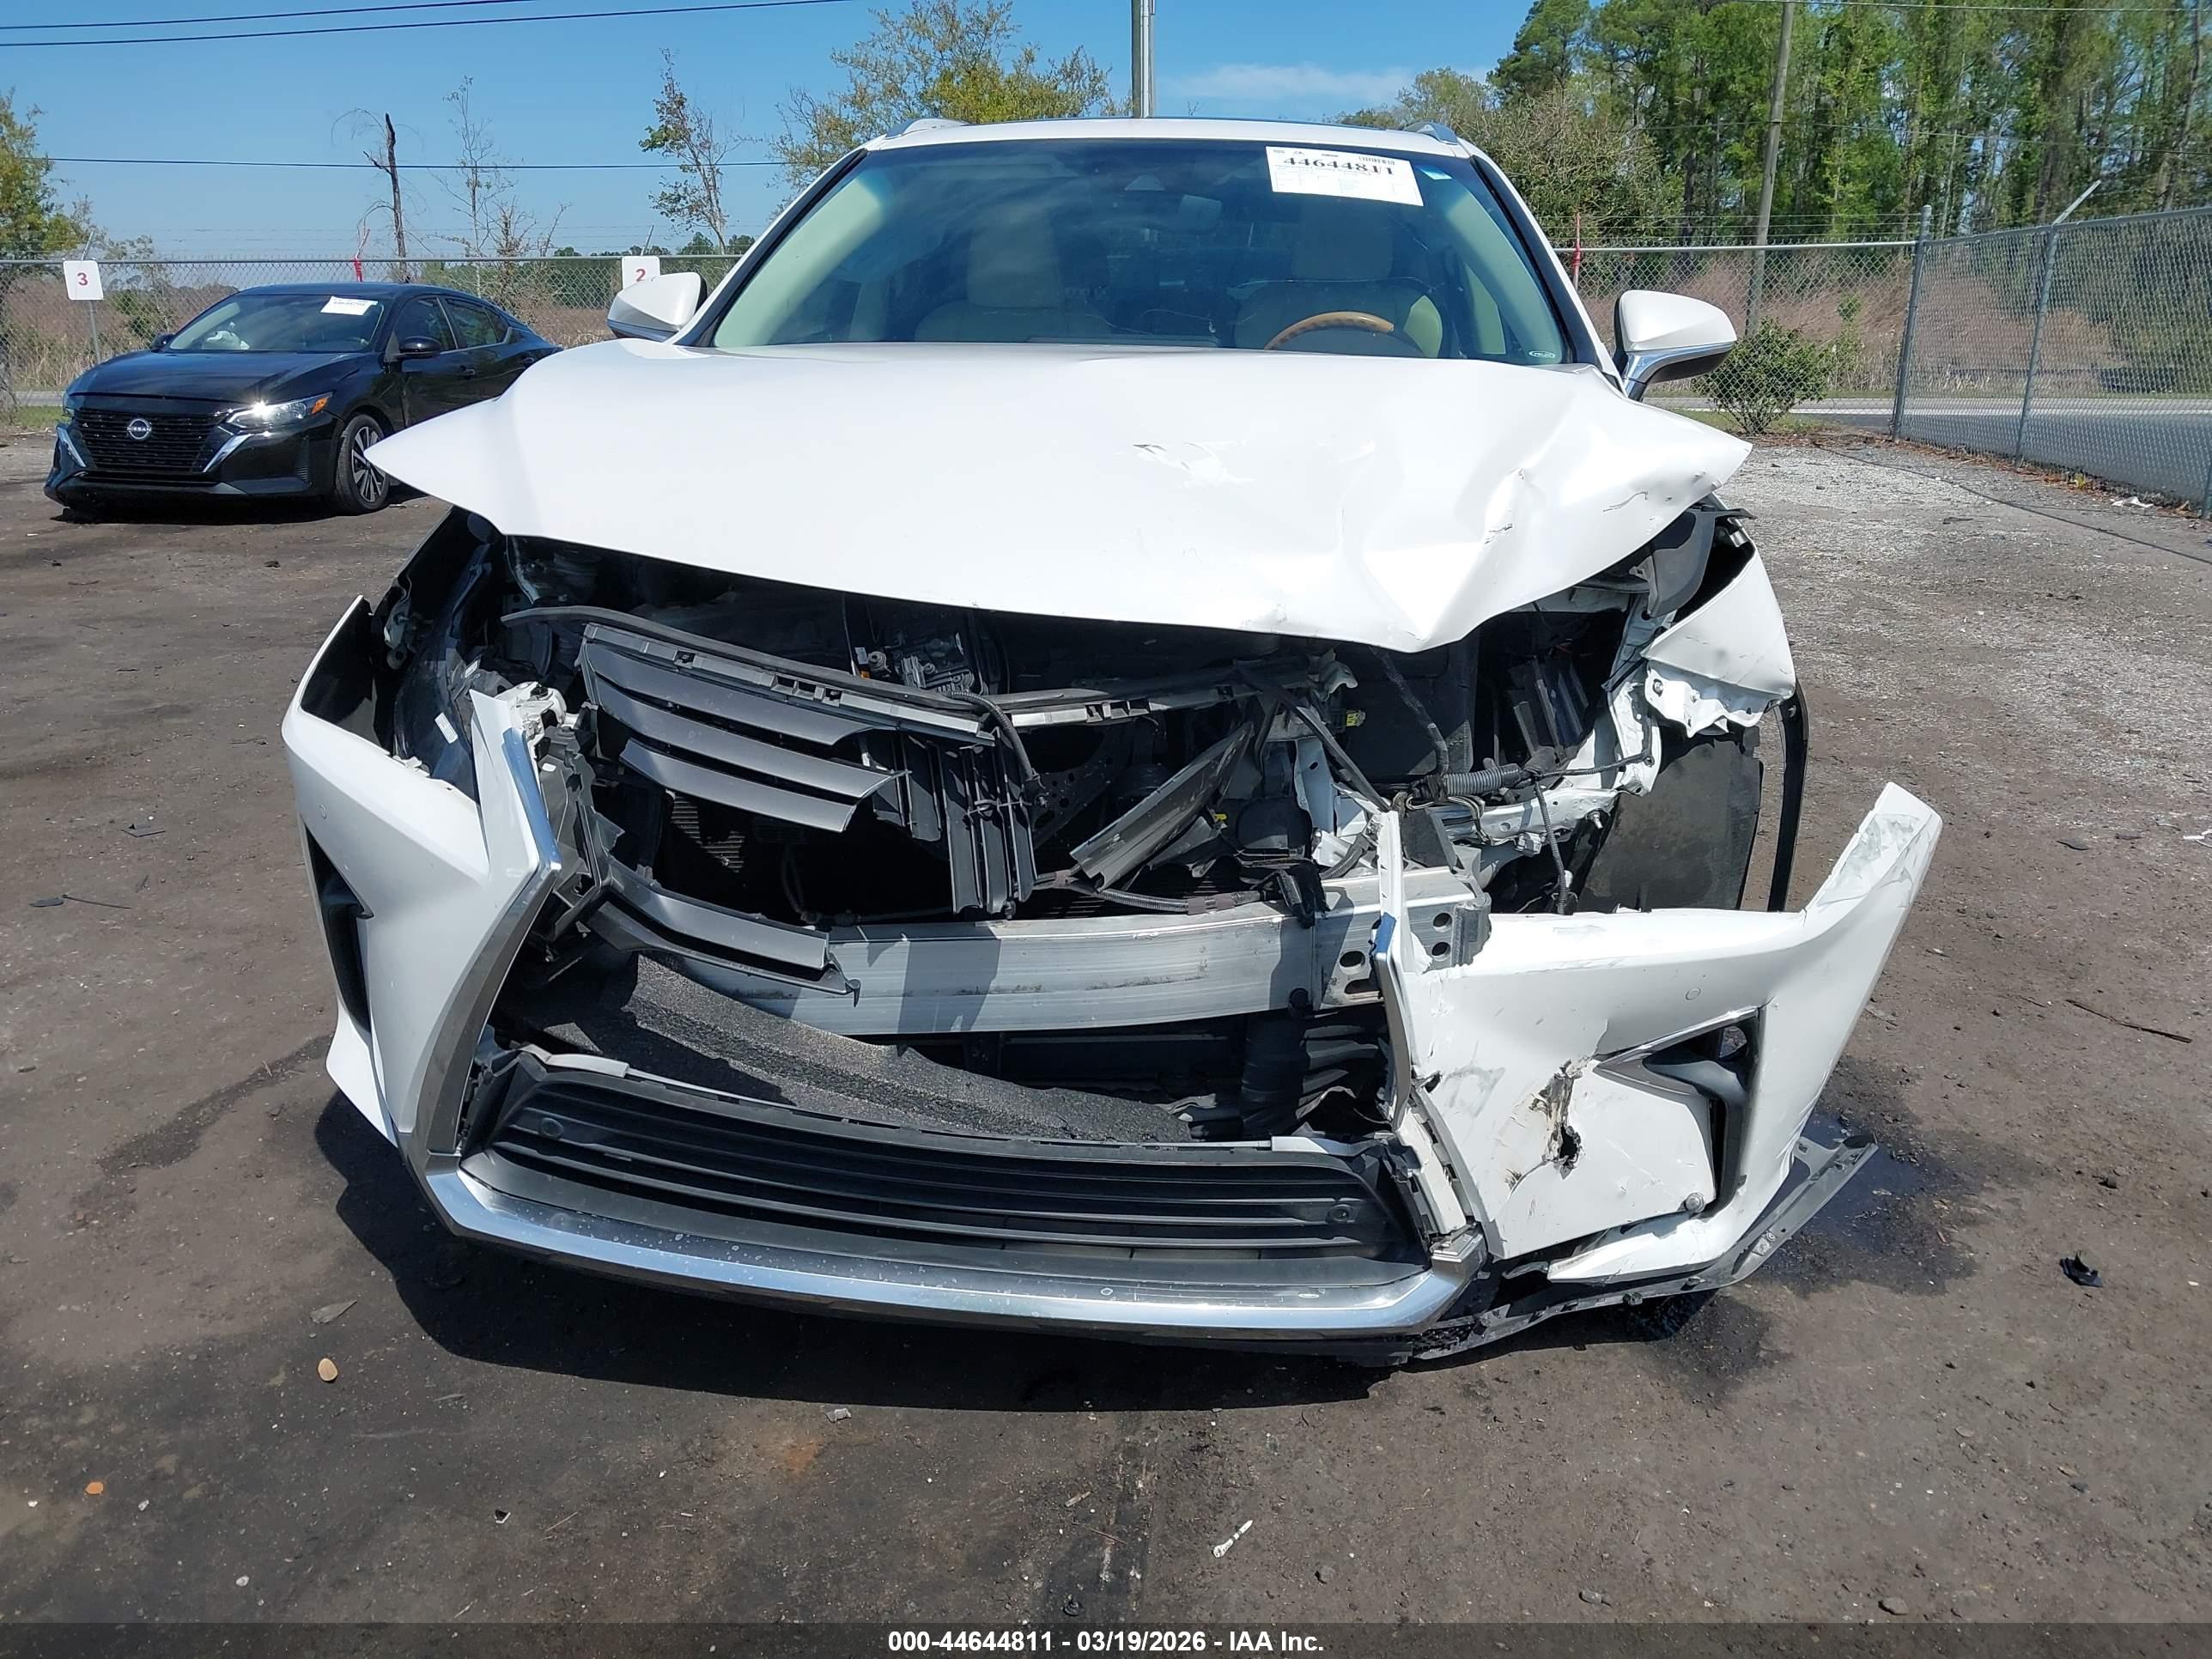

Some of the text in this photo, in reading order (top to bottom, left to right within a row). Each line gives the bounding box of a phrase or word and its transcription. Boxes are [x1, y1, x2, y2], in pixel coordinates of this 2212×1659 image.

[1284, 157, 1393, 175] 44644811
[76, 272, 88, 286] 3
[635, 268, 647, 283] 2
